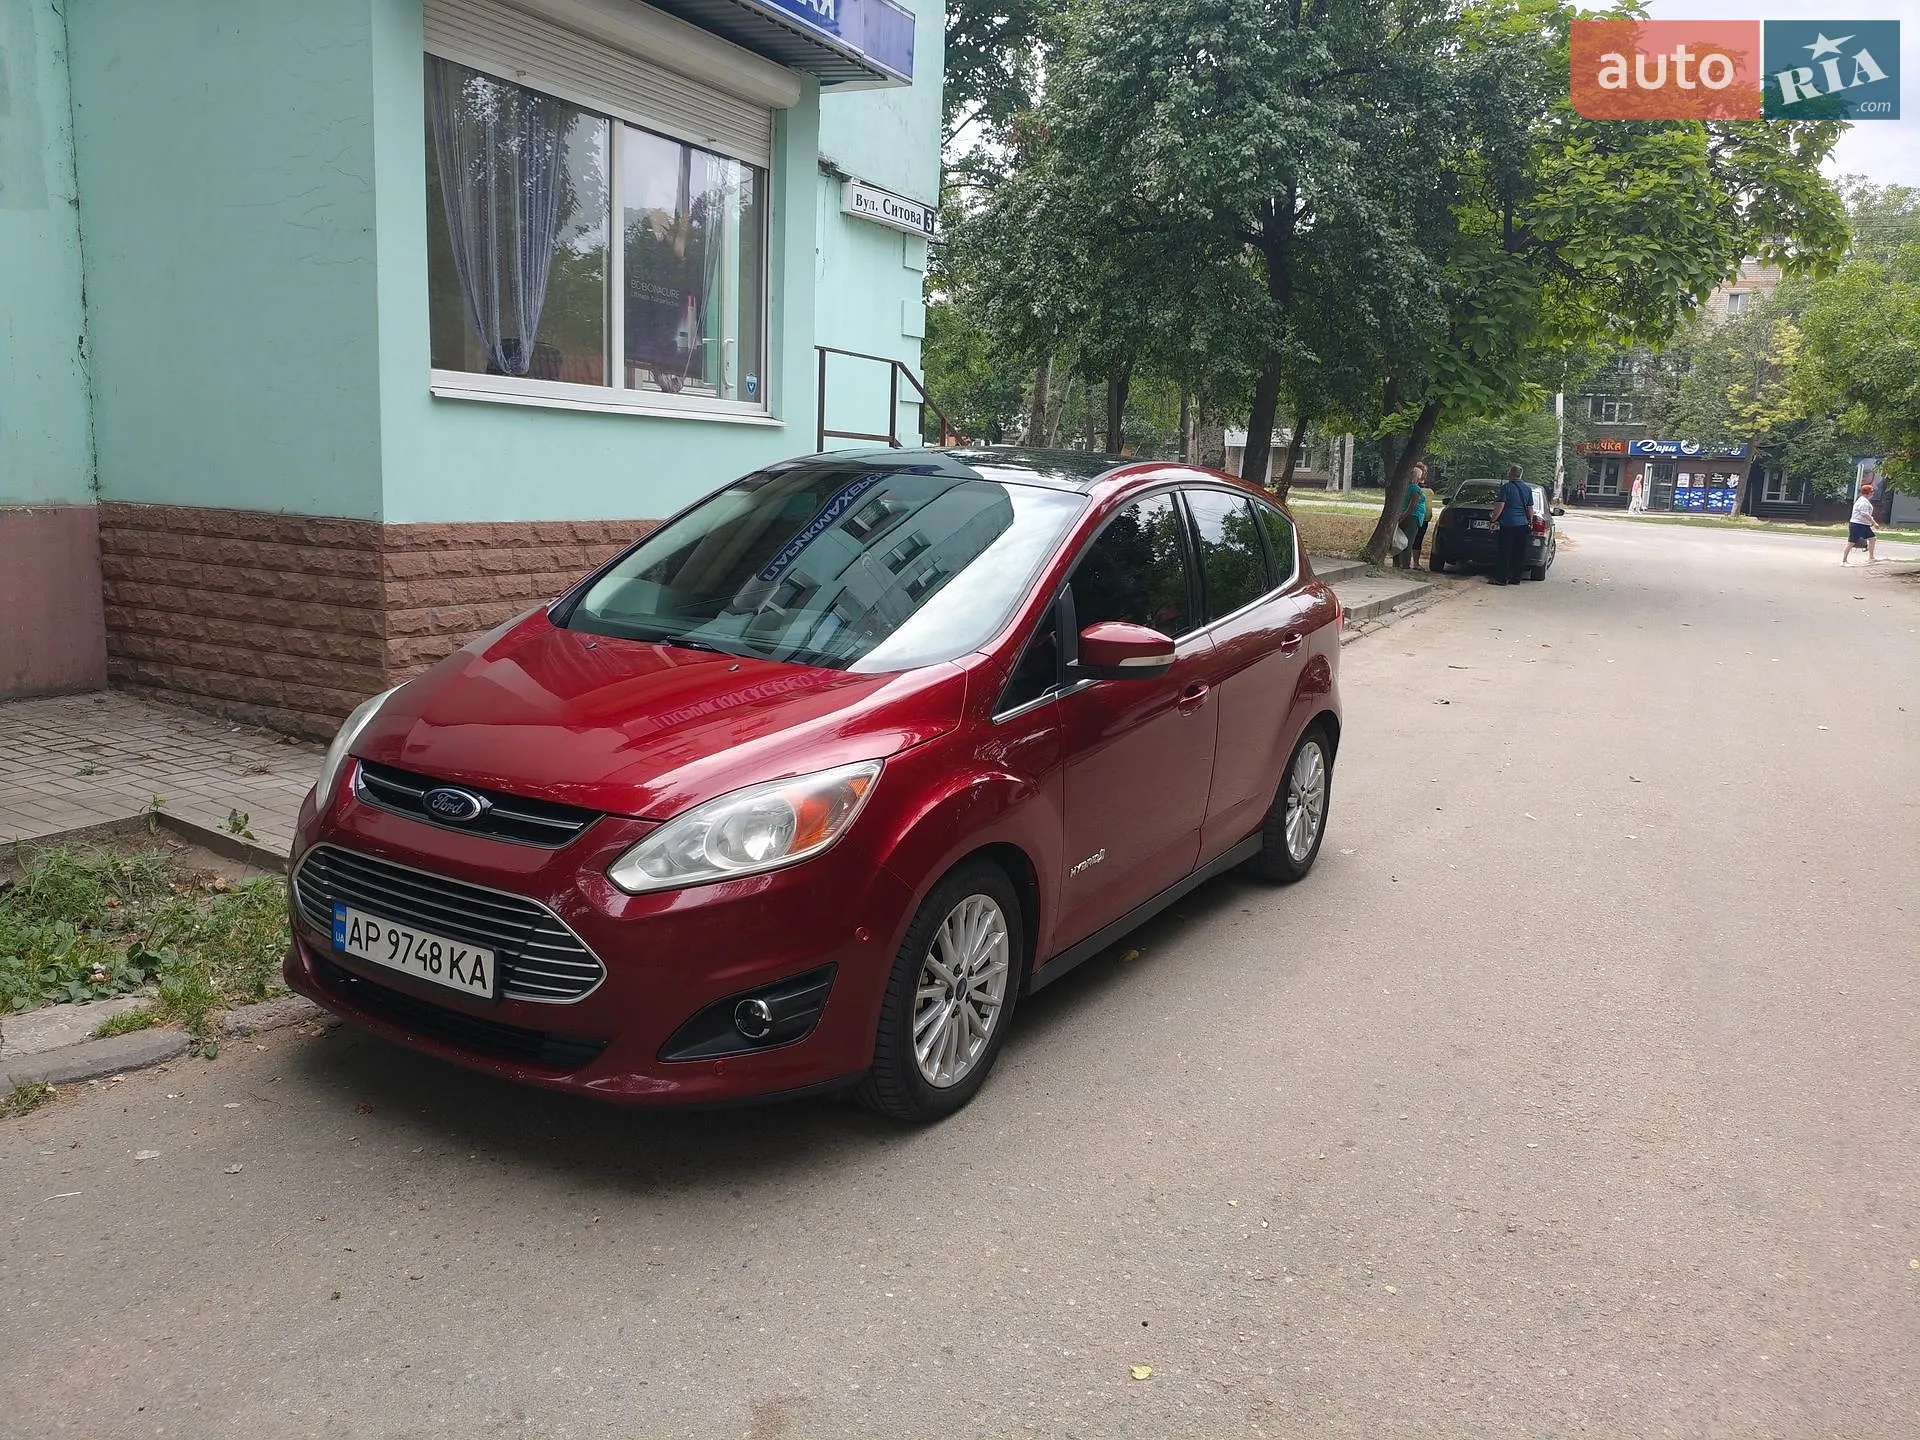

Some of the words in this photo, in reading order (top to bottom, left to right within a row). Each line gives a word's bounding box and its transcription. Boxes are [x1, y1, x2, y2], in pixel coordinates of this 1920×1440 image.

[855, 193, 879, 214] Вул.
[926, 212, 933, 232] 3
[431, 793, 463, 815] Ford
[335, 932, 345, 944] UA
[349, 917, 381, 951] AP
[388, 929, 442, 974] 9748
[449, 947, 487, 990] KA
